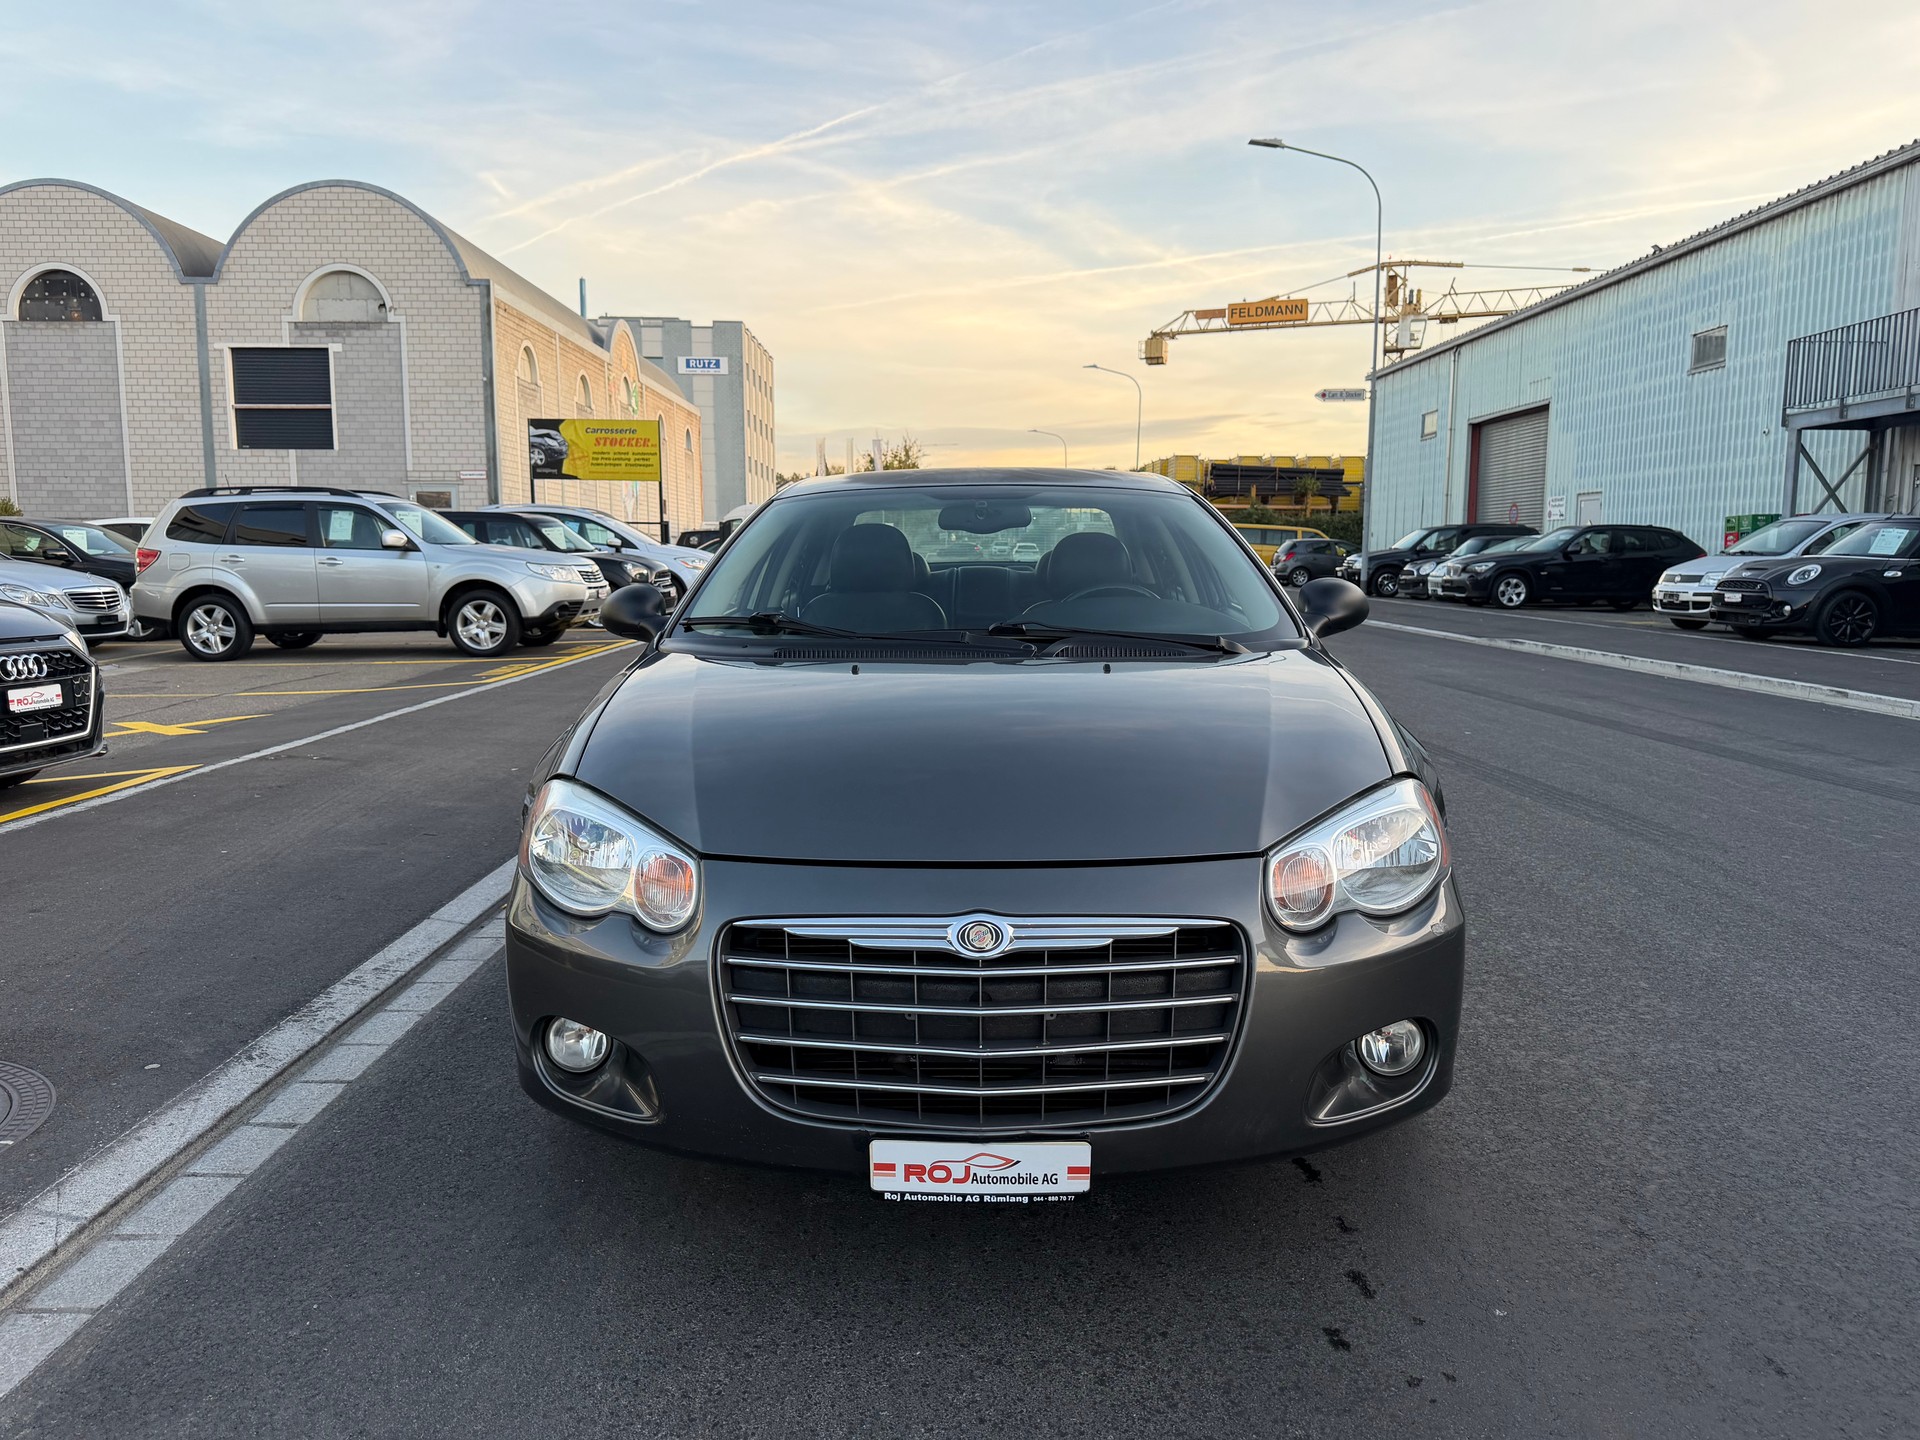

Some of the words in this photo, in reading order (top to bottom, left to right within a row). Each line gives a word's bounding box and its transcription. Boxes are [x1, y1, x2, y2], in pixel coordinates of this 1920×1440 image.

[1230, 303, 1304, 319] FELDMANN
[689, 359, 717, 368] RUTZ
[585, 427, 637, 435] Carrosserie
[594, 437, 650, 447] STOCKER
[16, 697, 34, 707] ROJ
[903, 1163, 971, 1184] ROJ
[970, 1172, 1039, 1185] Automobile
[1042, 1173, 1059, 1185] AG
[884, 1192, 901, 1202] Roj
[904, 1192, 963, 1203] Automobile
[965, 1194, 980, 1203] AG
[984, 1194, 1029, 1204] Rümlang
